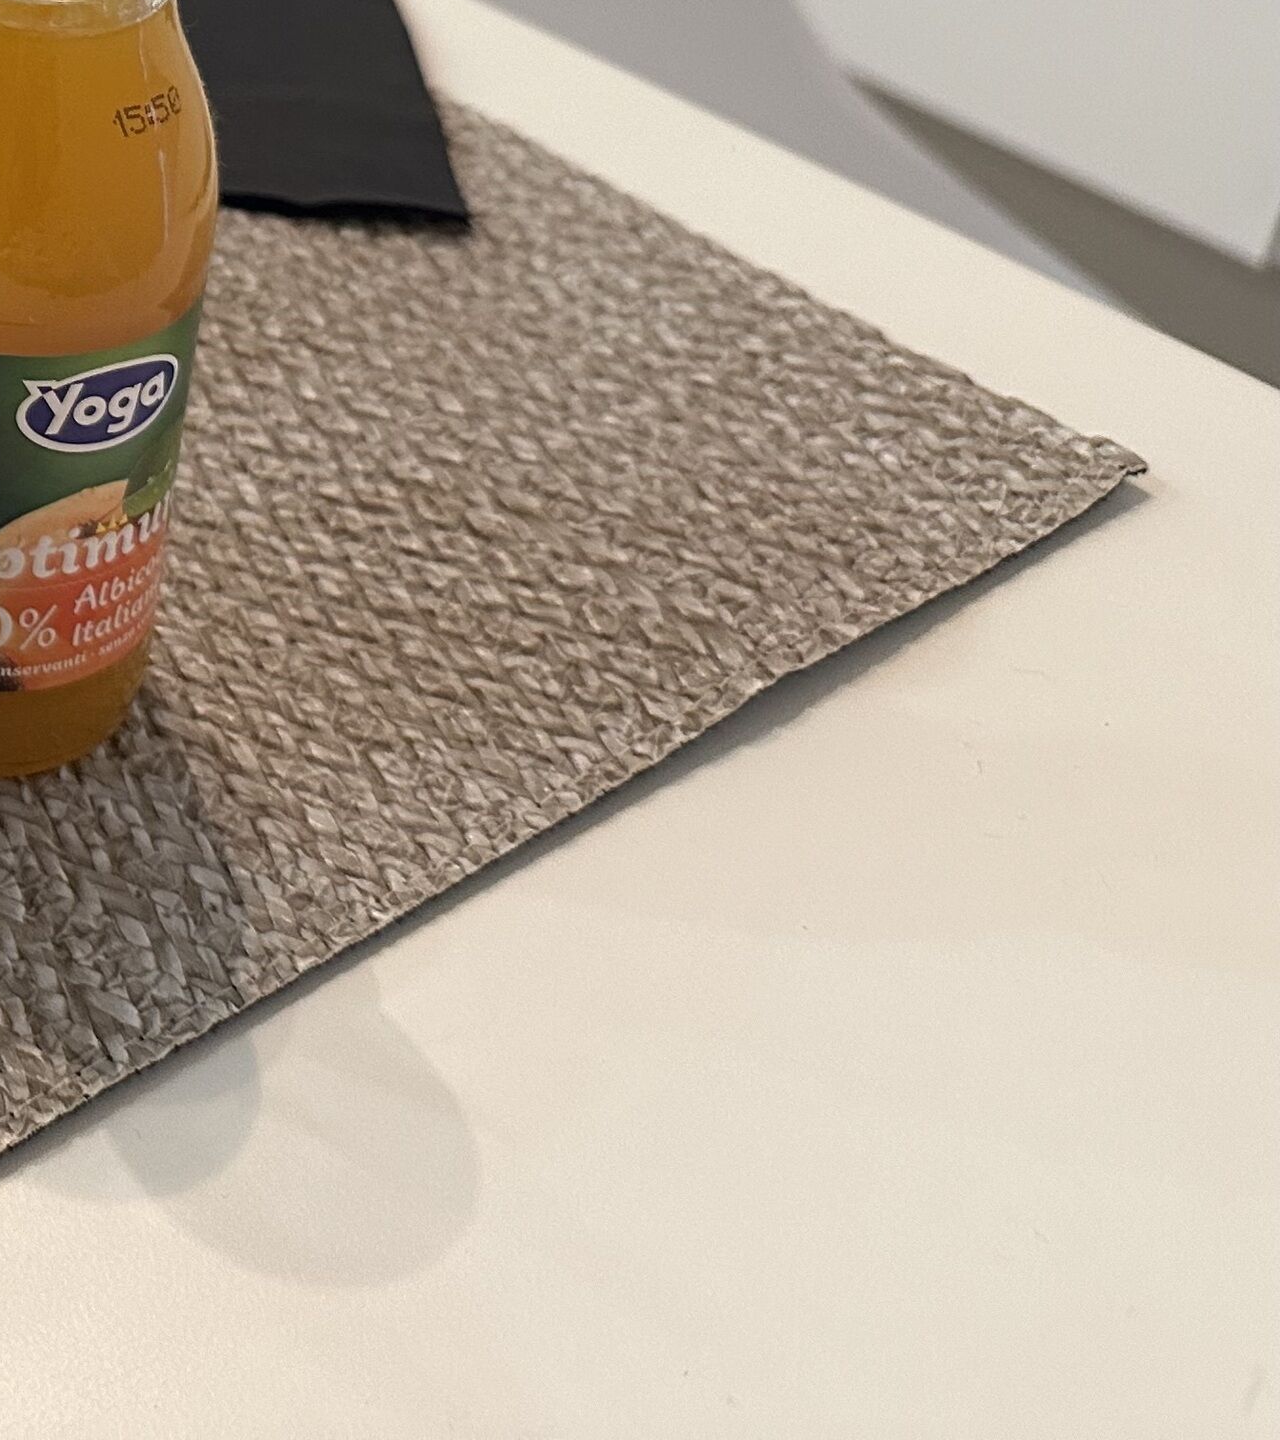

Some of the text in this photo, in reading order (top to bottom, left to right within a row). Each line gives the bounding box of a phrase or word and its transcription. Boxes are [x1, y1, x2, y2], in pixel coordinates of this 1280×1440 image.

[112, 85, 184, 138] 15:50
[30, 369, 167, 436] Yoga
[72, 557, 160, 615] Albico
